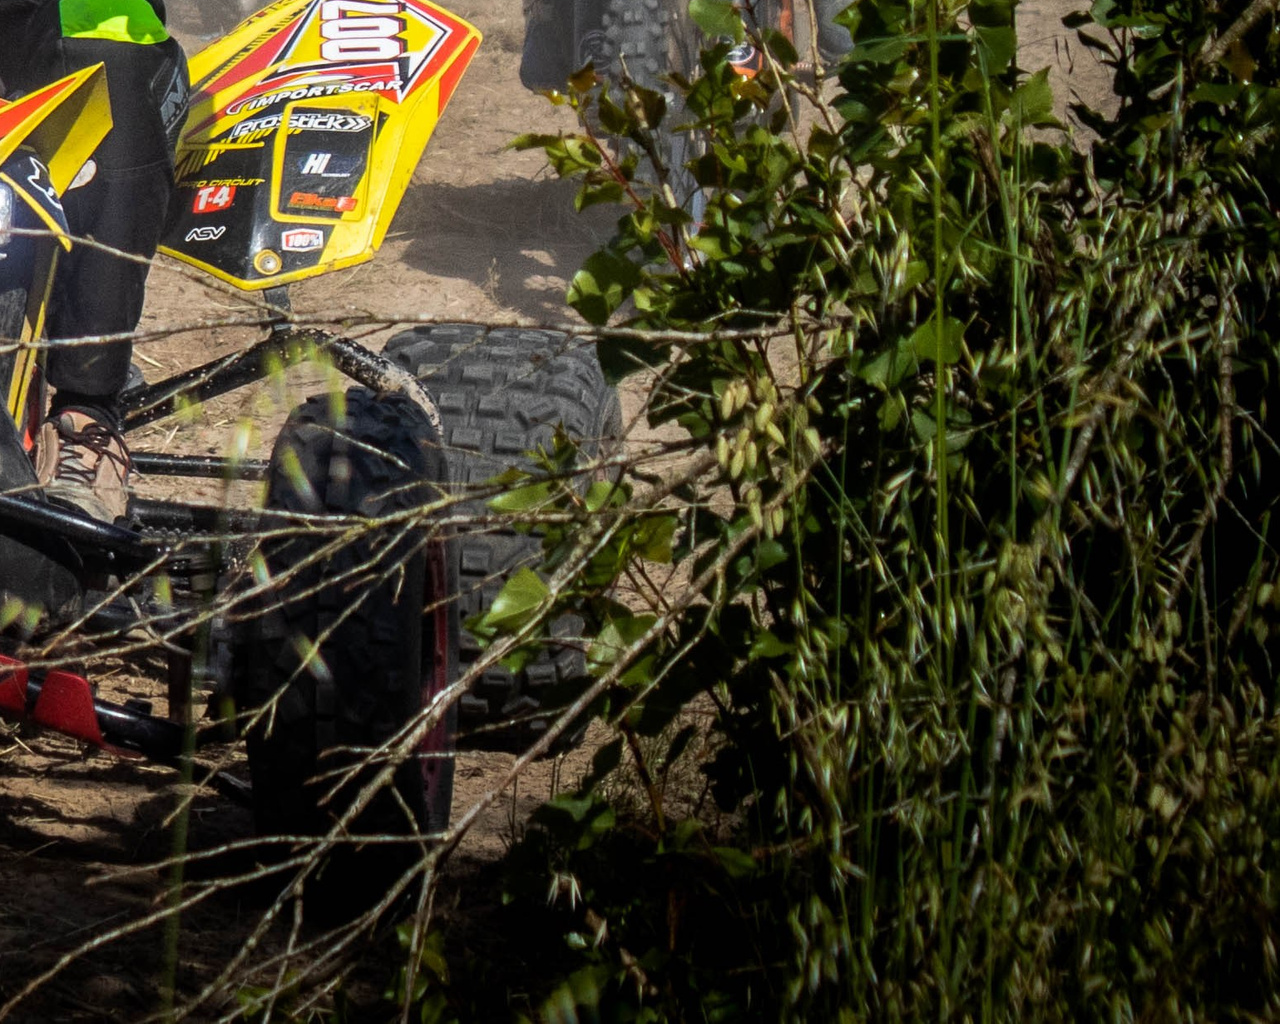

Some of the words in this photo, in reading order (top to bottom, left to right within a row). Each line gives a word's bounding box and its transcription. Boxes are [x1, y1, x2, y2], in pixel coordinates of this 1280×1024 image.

[208, 178, 266, 187] CIRCUIT
[198, 185, 231, 211] T-4
[185, 226, 227, 242] ASV
